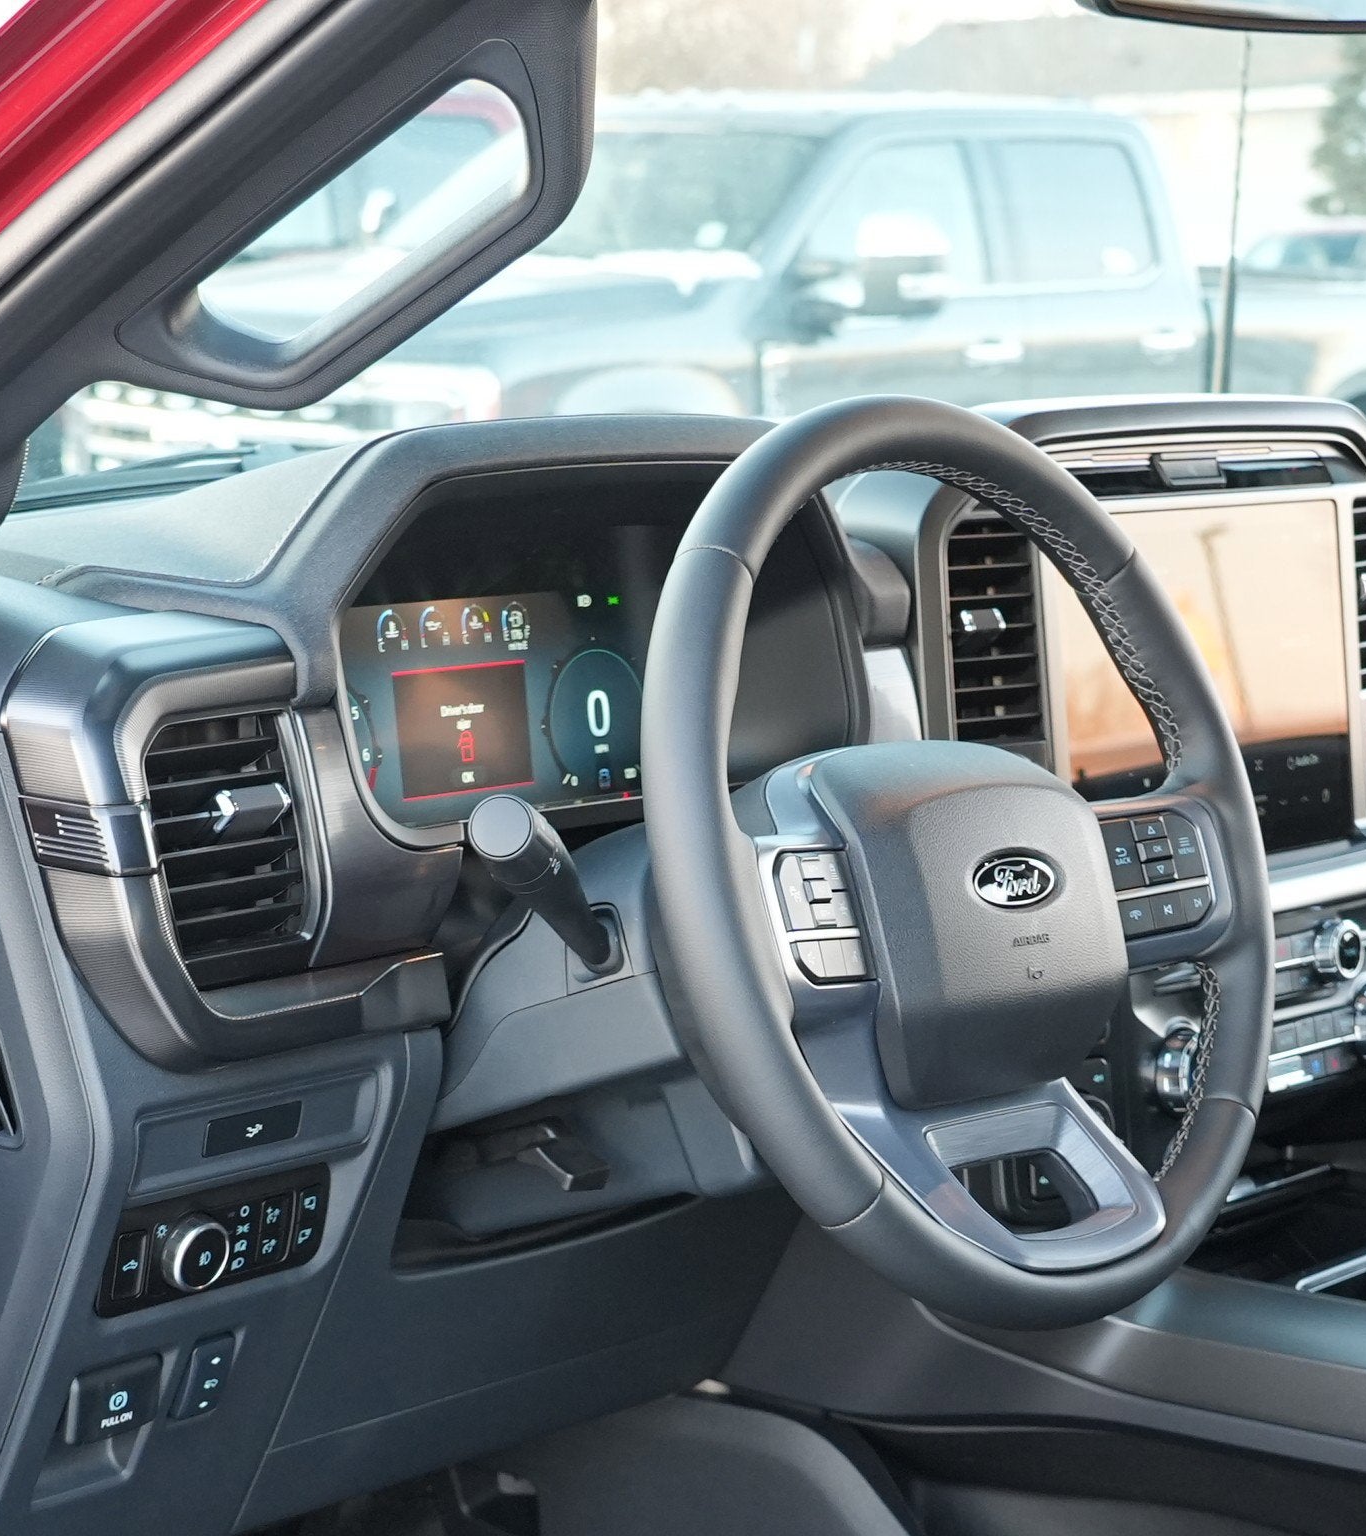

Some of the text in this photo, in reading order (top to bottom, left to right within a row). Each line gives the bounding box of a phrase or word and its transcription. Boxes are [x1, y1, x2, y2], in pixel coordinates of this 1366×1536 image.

[351, 706, 360, 720] 5
[587, 689, 611, 738] 0
[361, 748, 371, 762] 6
[1152, 845, 1163, 853] OK
[1178, 847, 1195, 855] MENU
[1114, 856, 1132, 866] BACK
[993, 863, 1041, 897] Ford
[1013, 933, 1051, 947] AIRBAG
[100, 1411, 133, 1429] PULL ON
